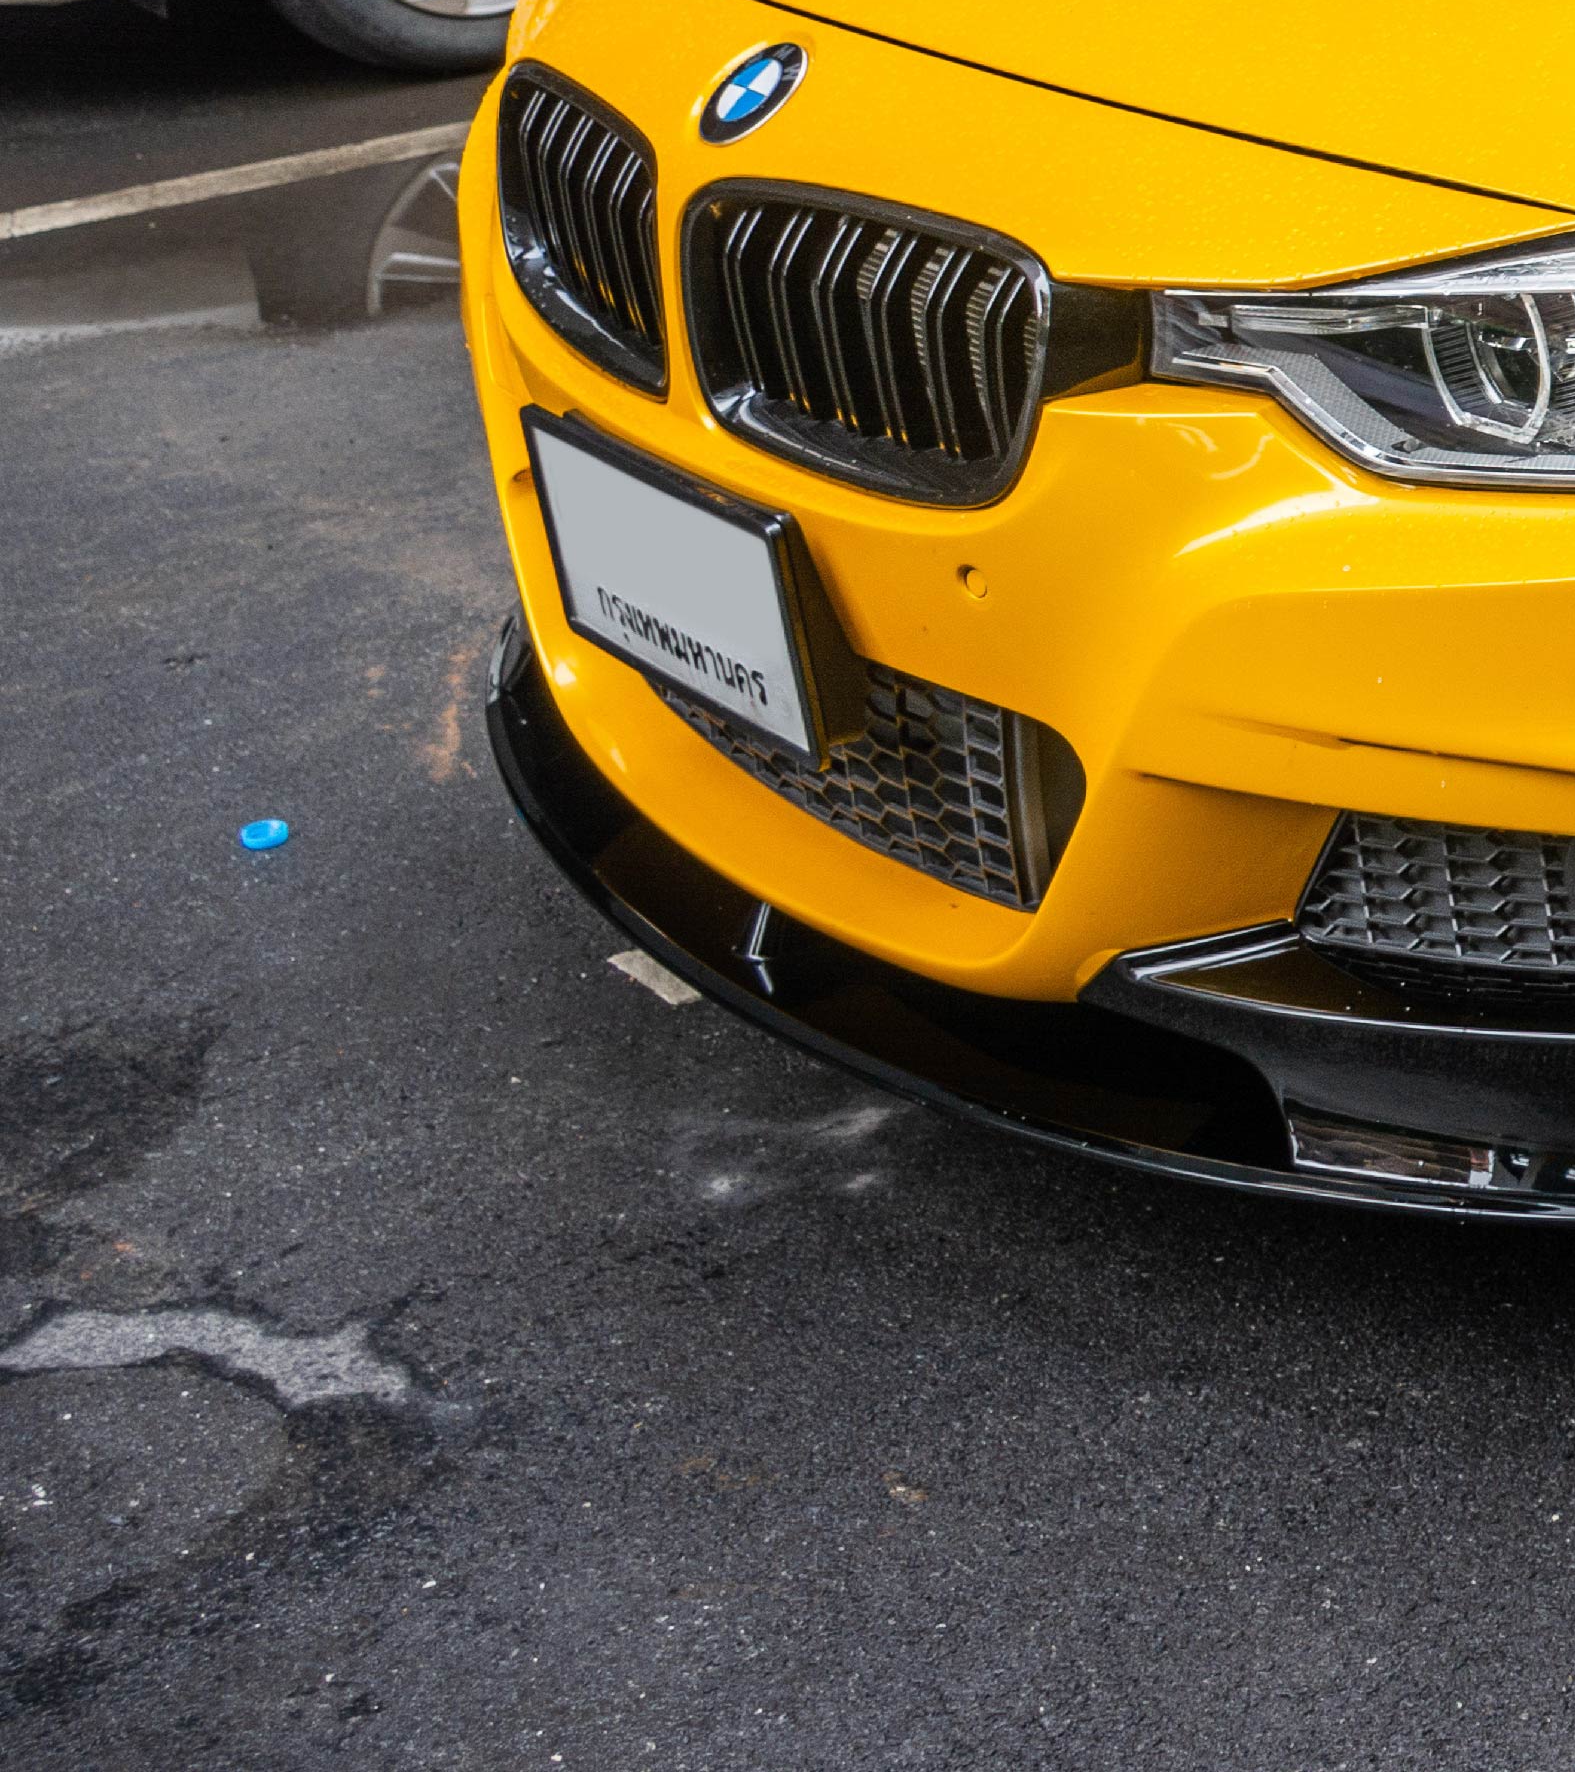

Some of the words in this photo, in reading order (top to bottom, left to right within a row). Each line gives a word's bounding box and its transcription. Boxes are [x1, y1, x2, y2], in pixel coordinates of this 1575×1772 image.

[597, 586, 768, 706] กรุงเทพมหานคร
